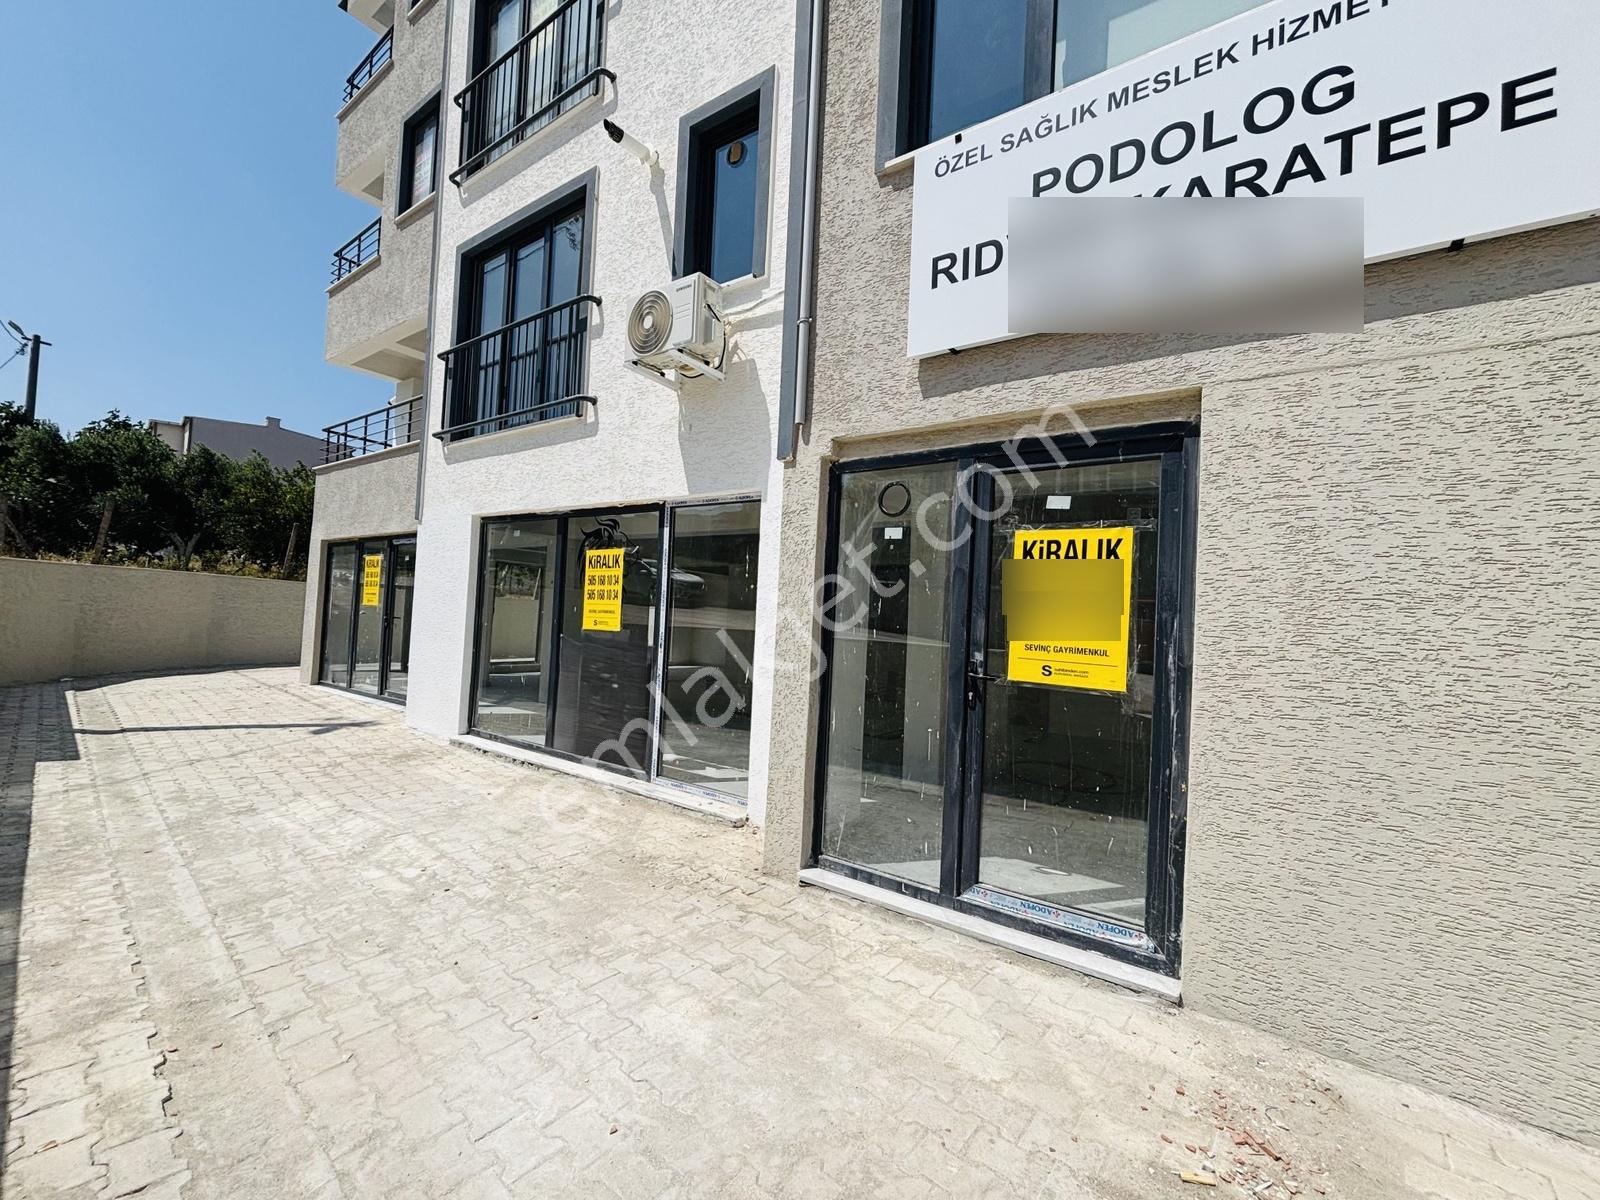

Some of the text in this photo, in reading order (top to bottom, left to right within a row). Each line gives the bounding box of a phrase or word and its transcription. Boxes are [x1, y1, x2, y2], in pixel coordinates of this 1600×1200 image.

[934, 0, 1389, 178] ÖZEL SAĞLIK MESLEK HİZME
[1032, 65, 1356, 197] PODOLOG
[930, 67, 1558, 290] RID RATEPE
[1024, 642, 1110, 658] SEVİNÇ GAYRİMENKUL
[1041, 665, 1053, 677] S
